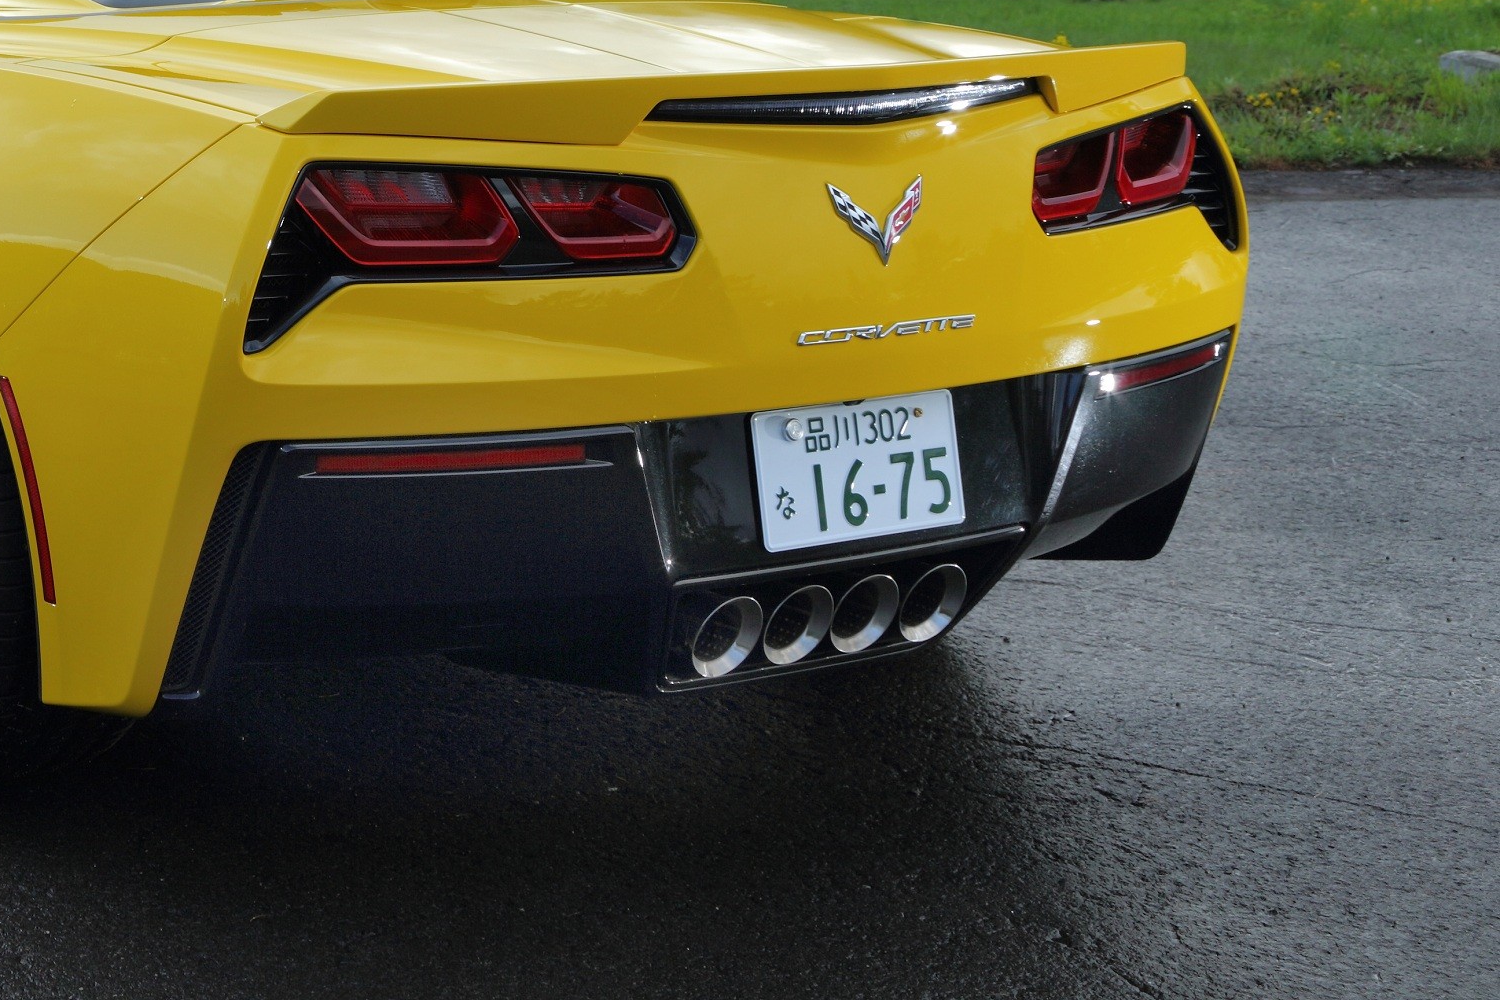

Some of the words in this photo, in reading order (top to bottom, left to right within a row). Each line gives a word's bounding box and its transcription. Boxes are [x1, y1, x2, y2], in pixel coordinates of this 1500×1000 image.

[796, 313, 976, 347] CORVETTE
[775, 485, 798, 520] な
[813, 446, 952, 532] 16-75
